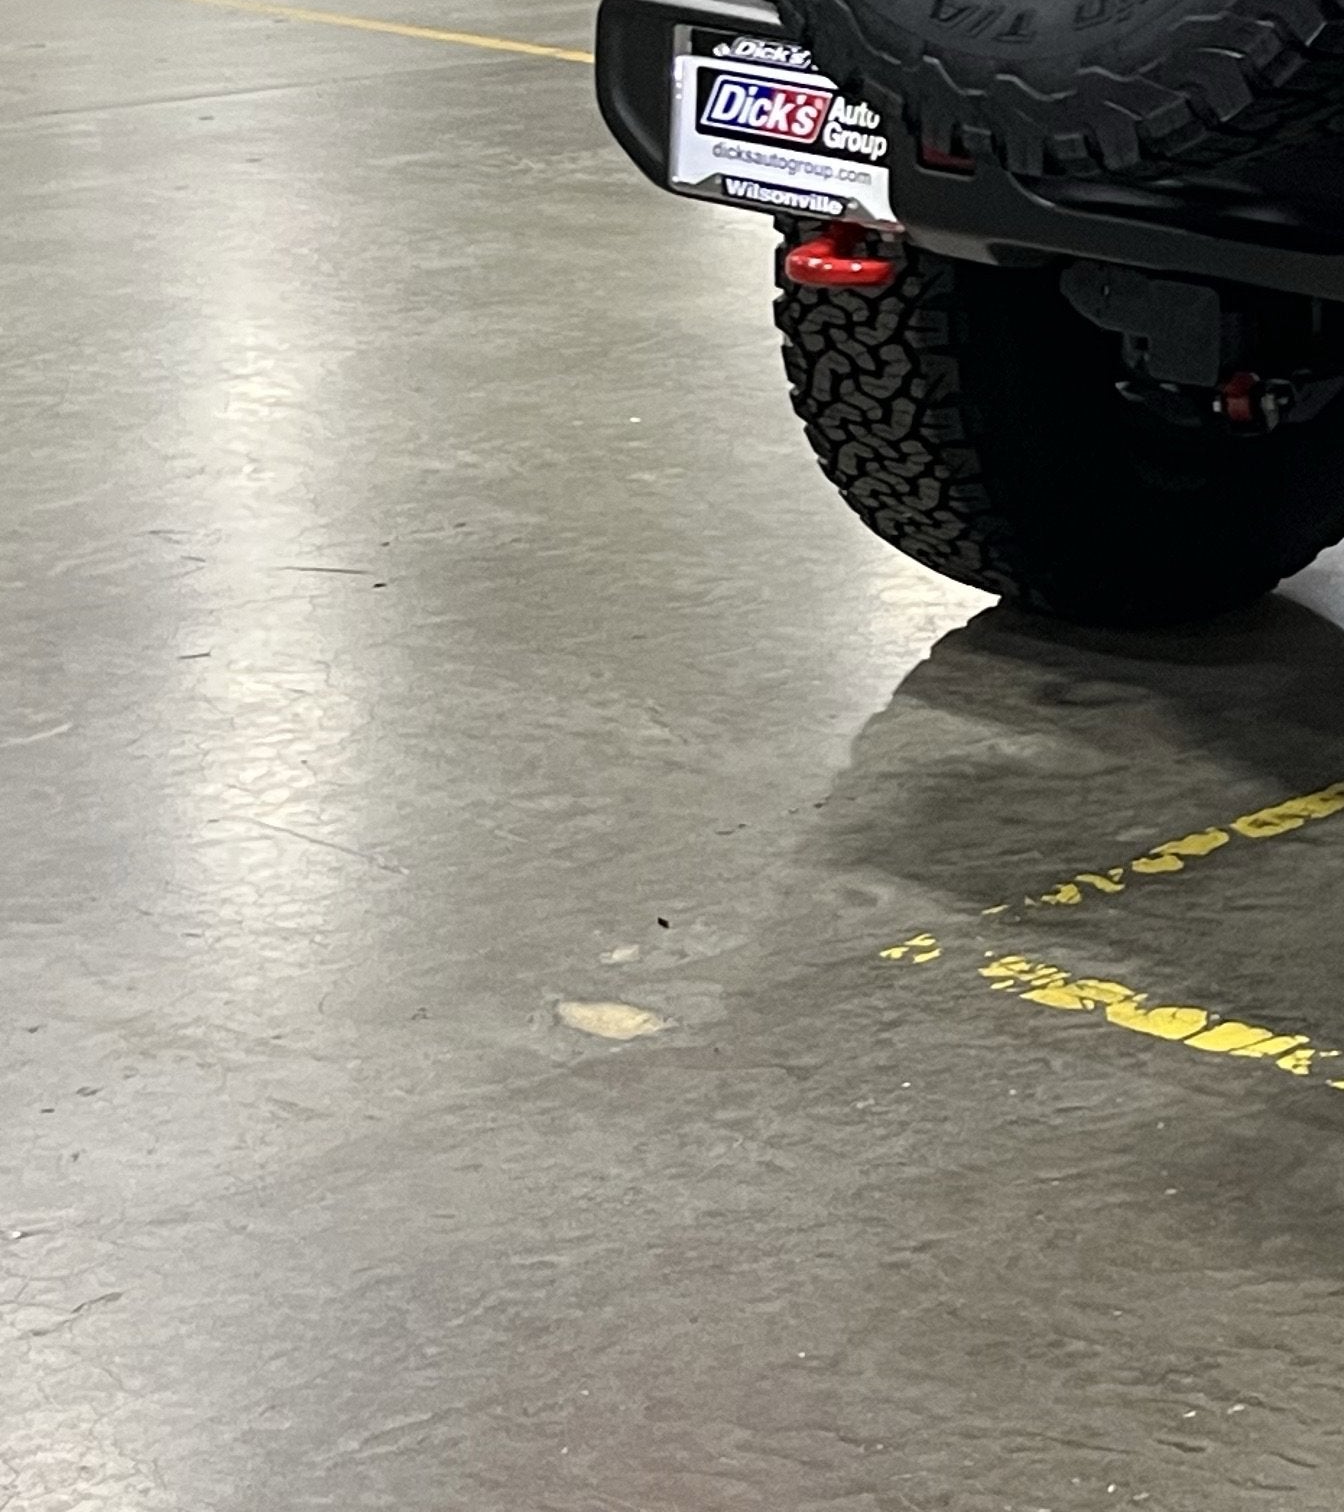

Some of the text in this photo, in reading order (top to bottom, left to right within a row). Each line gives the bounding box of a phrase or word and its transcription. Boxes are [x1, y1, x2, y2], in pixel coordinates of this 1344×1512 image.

[710, 82, 819, 136] Dick's
[828, 96, 881, 130] Auto
[823, 121, 888, 162] Group
[711, 142, 873, 186] dicksautogroup.com
[725, 177, 844, 216] Wilsonville
